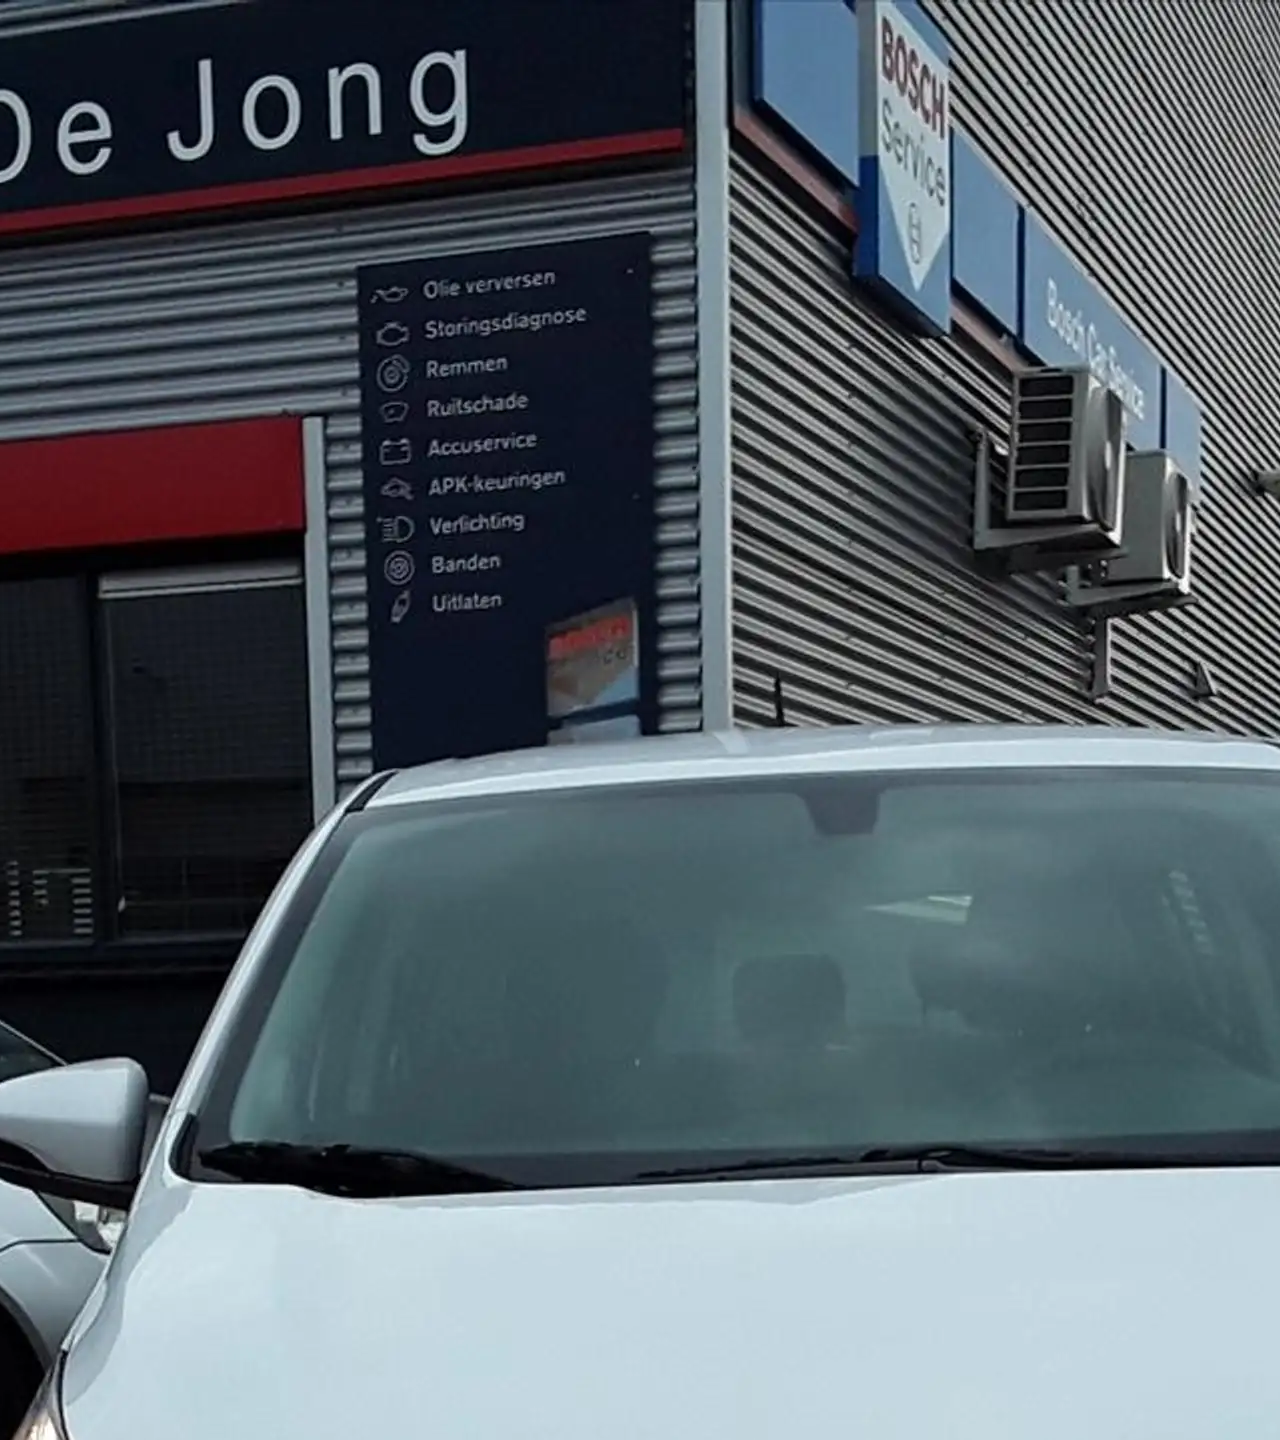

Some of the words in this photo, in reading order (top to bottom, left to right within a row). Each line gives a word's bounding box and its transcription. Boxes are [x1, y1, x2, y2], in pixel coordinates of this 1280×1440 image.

[882, 15, 945, 140] BOSCH
[166, 47, 470, 157] Jong
[882, 98, 946, 207] Service
[423, 278, 461, 301] Olie
[465, 270, 556, 296] verversen
[425, 305, 587, 341] Storingsdiagnose
[1047, 276, 1087, 361] Bosch
[426, 355, 509, 379] Remmen
[427, 392, 529, 418] Ruitschade
[428, 431, 538, 458] Accuservice
[428, 468, 566, 497] APK-keuringen
[430, 511, 525, 537] Verlichting
[432, 553, 501, 574] Banden
[432, 590, 502, 614] Uitlaten
